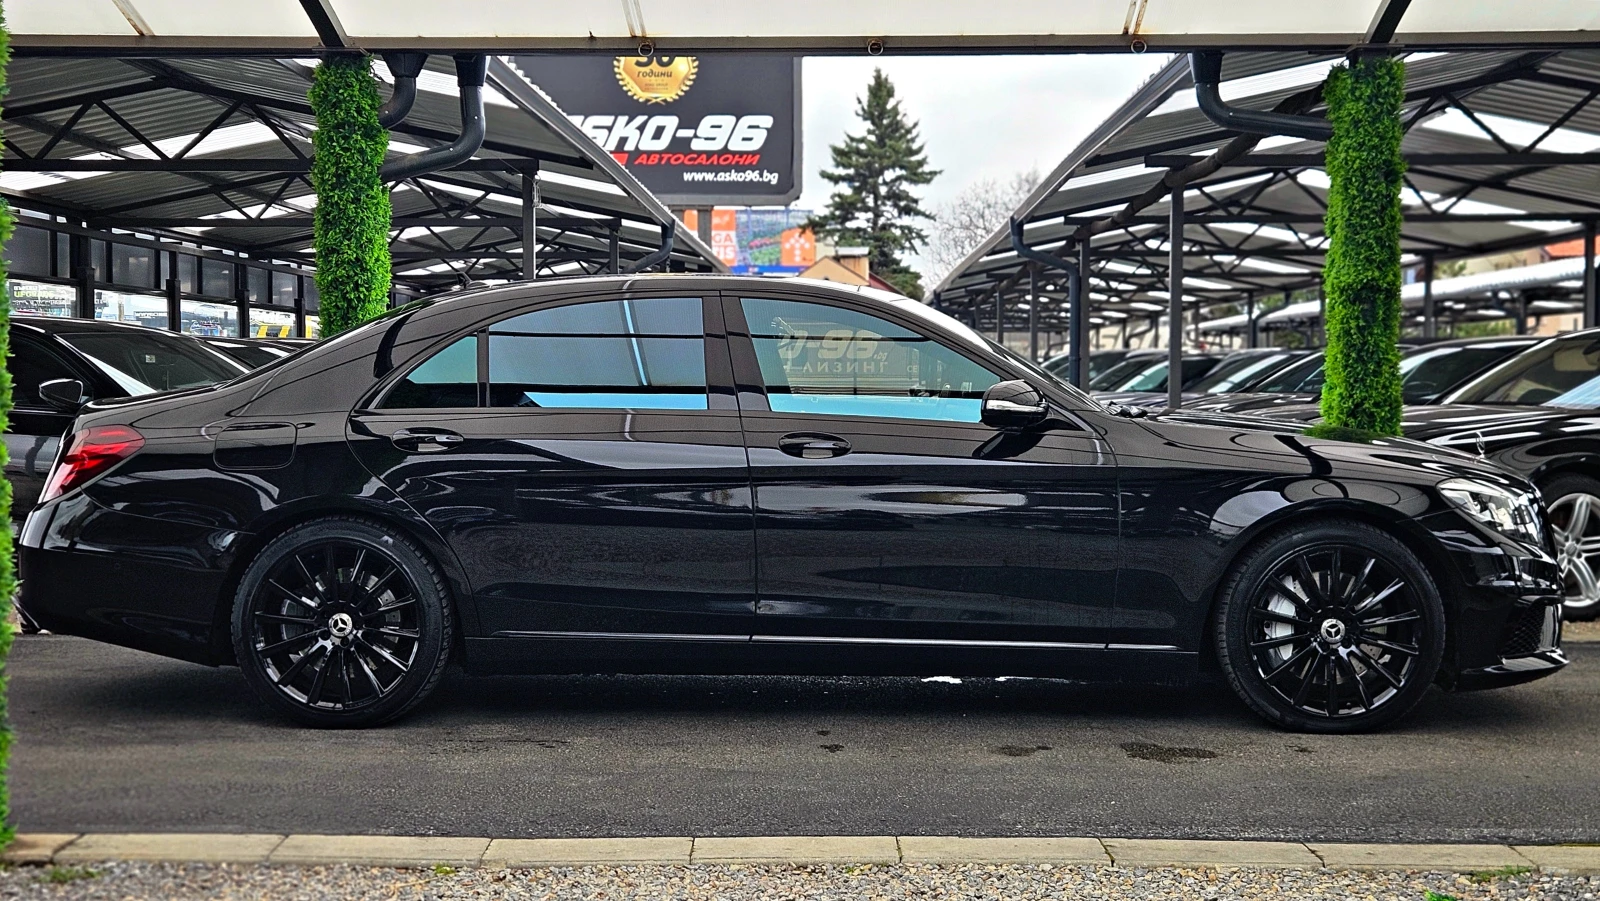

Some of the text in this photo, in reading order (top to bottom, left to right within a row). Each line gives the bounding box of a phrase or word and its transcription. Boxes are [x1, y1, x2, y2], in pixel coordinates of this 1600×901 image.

[637, 68, 673, 78] години
[633, 153, 761, 165] АВТОСАЛОНИ
[682, 169, 779, 185] www.asko96.bg
